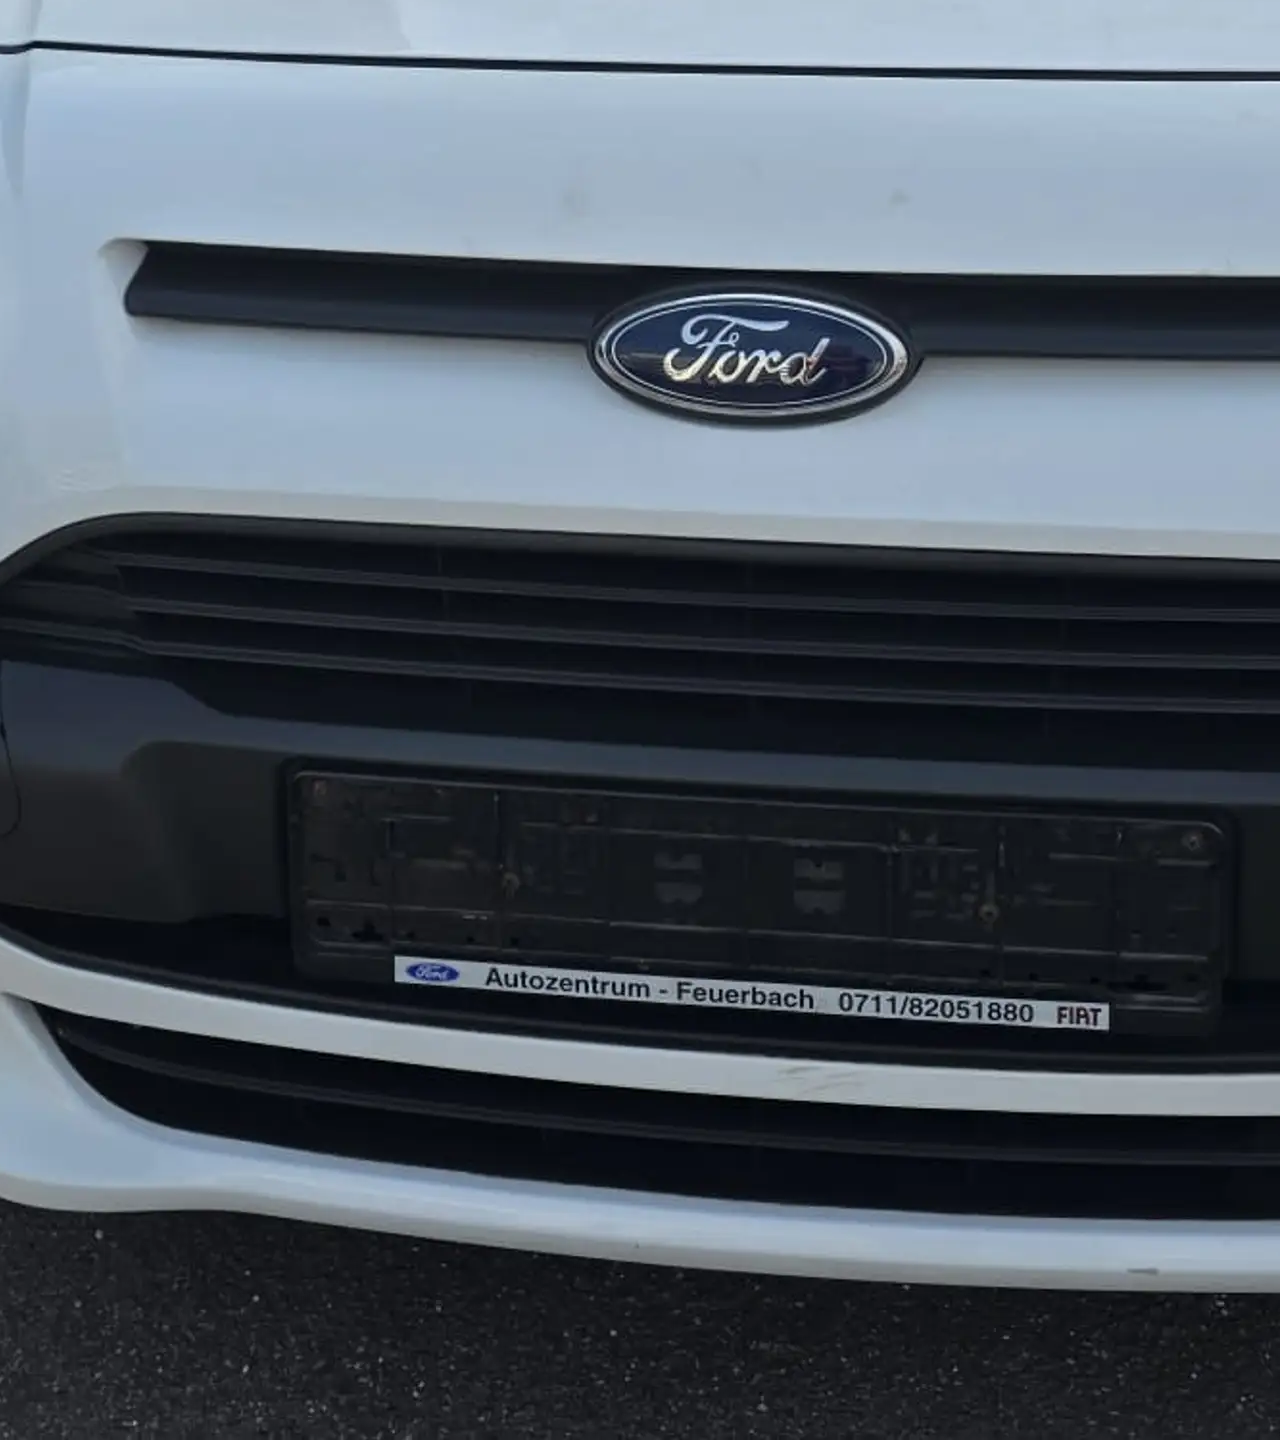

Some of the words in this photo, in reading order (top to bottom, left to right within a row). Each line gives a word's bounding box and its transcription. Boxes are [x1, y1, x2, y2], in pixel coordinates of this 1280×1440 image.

[662, 313, 828, 385] Ford
[485, 967, 651, 999] Autozentrum
[677, 981, 815, 1010] Feuerbach
[838, 992, 1035, 1023] 0711/82051880
[1056, 1006, 1103, 1027] FIAT
